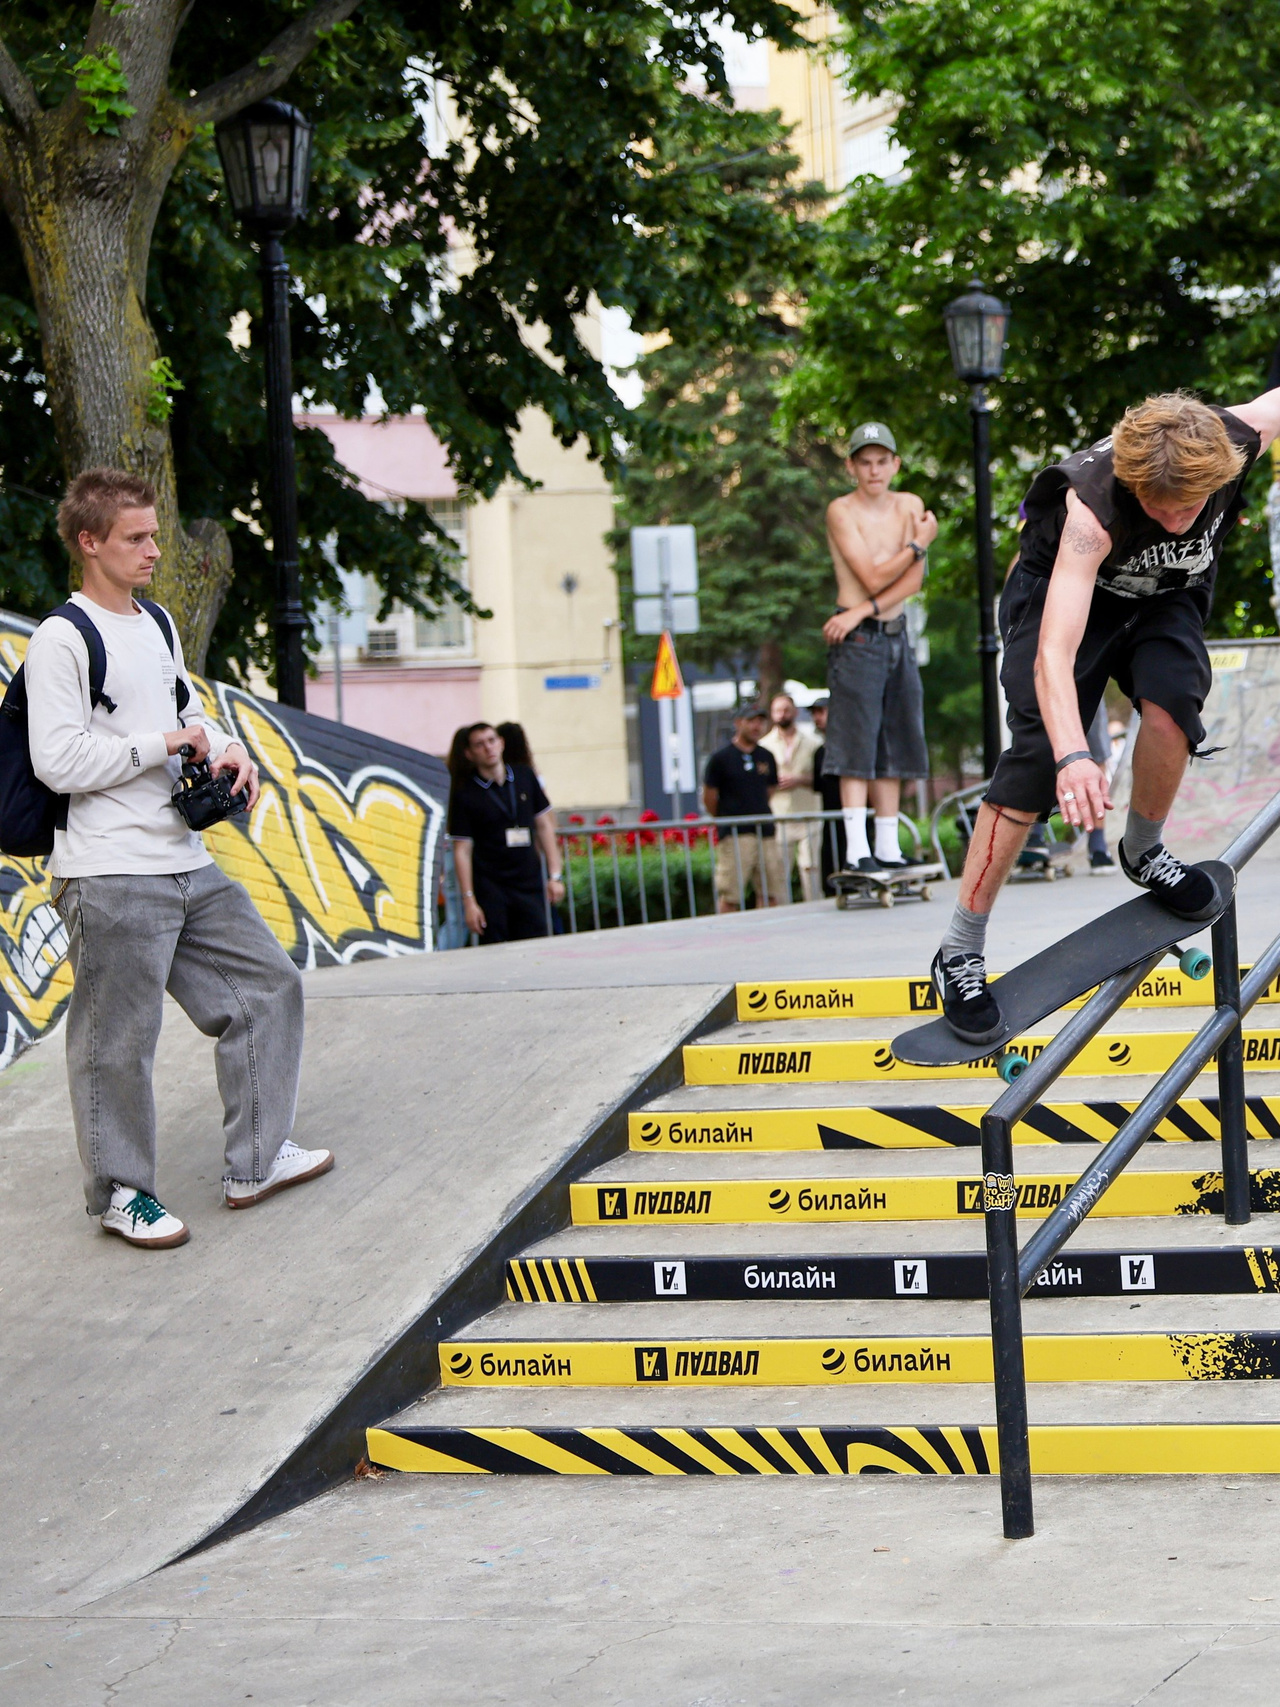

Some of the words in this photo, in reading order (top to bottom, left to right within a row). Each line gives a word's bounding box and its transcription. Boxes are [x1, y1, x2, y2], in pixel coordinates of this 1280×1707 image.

[775, 989, 854, 1009] билайн
[1129, 977, 1182, 997] айн
[738, 1051, 811, 1075] ПАДВАЛ
[668, 1122, 753, 1144] билайн
[633, 1190, 712, 1215] ПАДВАЛ
[798, 1188, 887, 1211] билайн
[743, 1265, 835, 1290] билайн
[1034, 1263, 1082, 1286] айн
[480, 1352, 571, 1377] билайн
[674, 1350, 759, 1377] ПАДВАЛ
[854, 1348, 950, 1373] билайн
